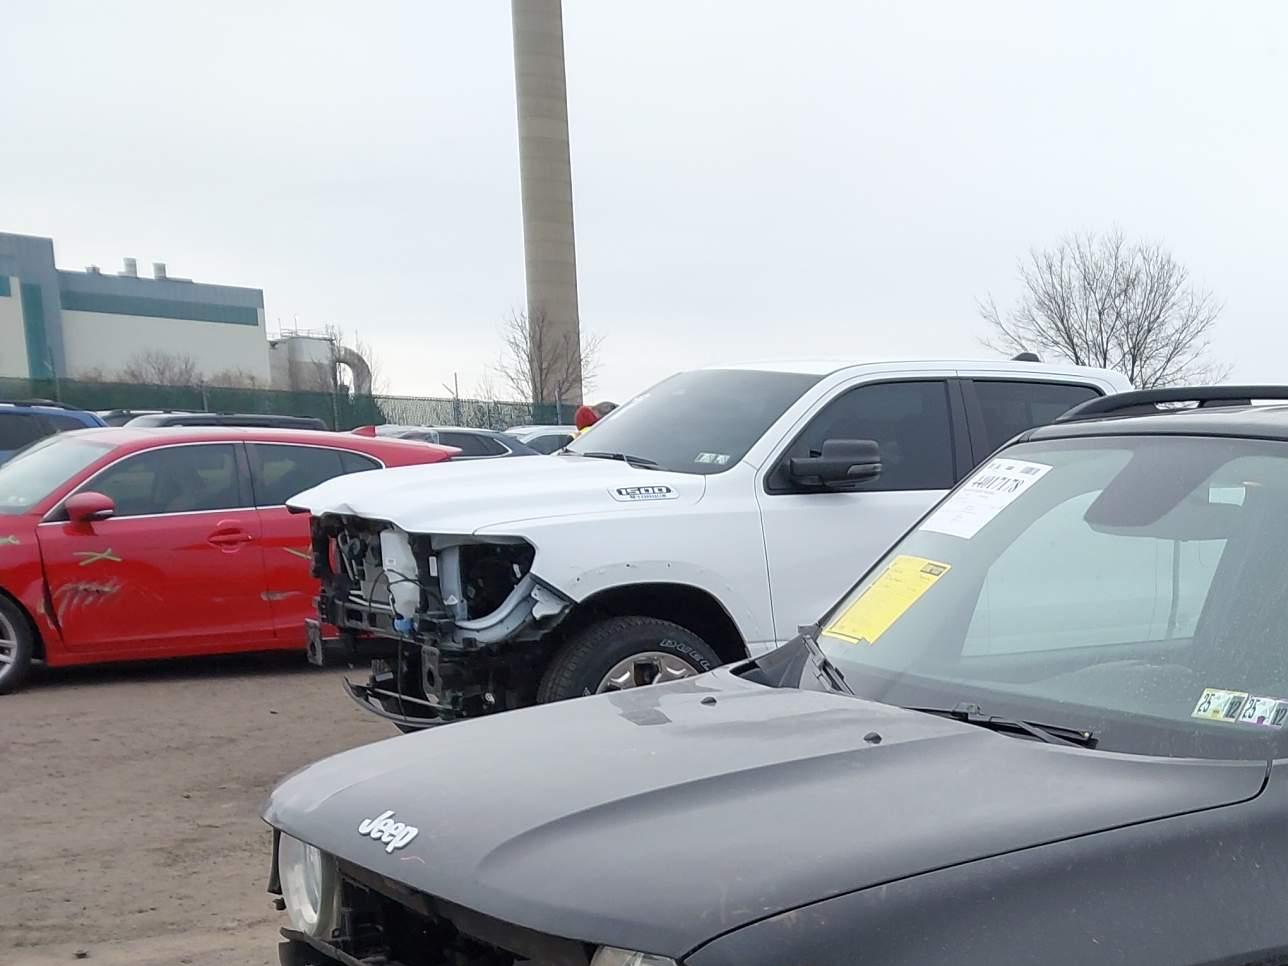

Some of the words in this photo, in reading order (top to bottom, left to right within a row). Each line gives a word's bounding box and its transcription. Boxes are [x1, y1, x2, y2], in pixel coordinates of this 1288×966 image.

[617, 485, 668, 497] 1500
[1198, 693, 1216, 713] 25
[1242, 699, 1261, 719] 25
[358, 809, 419, 854] Jeep
